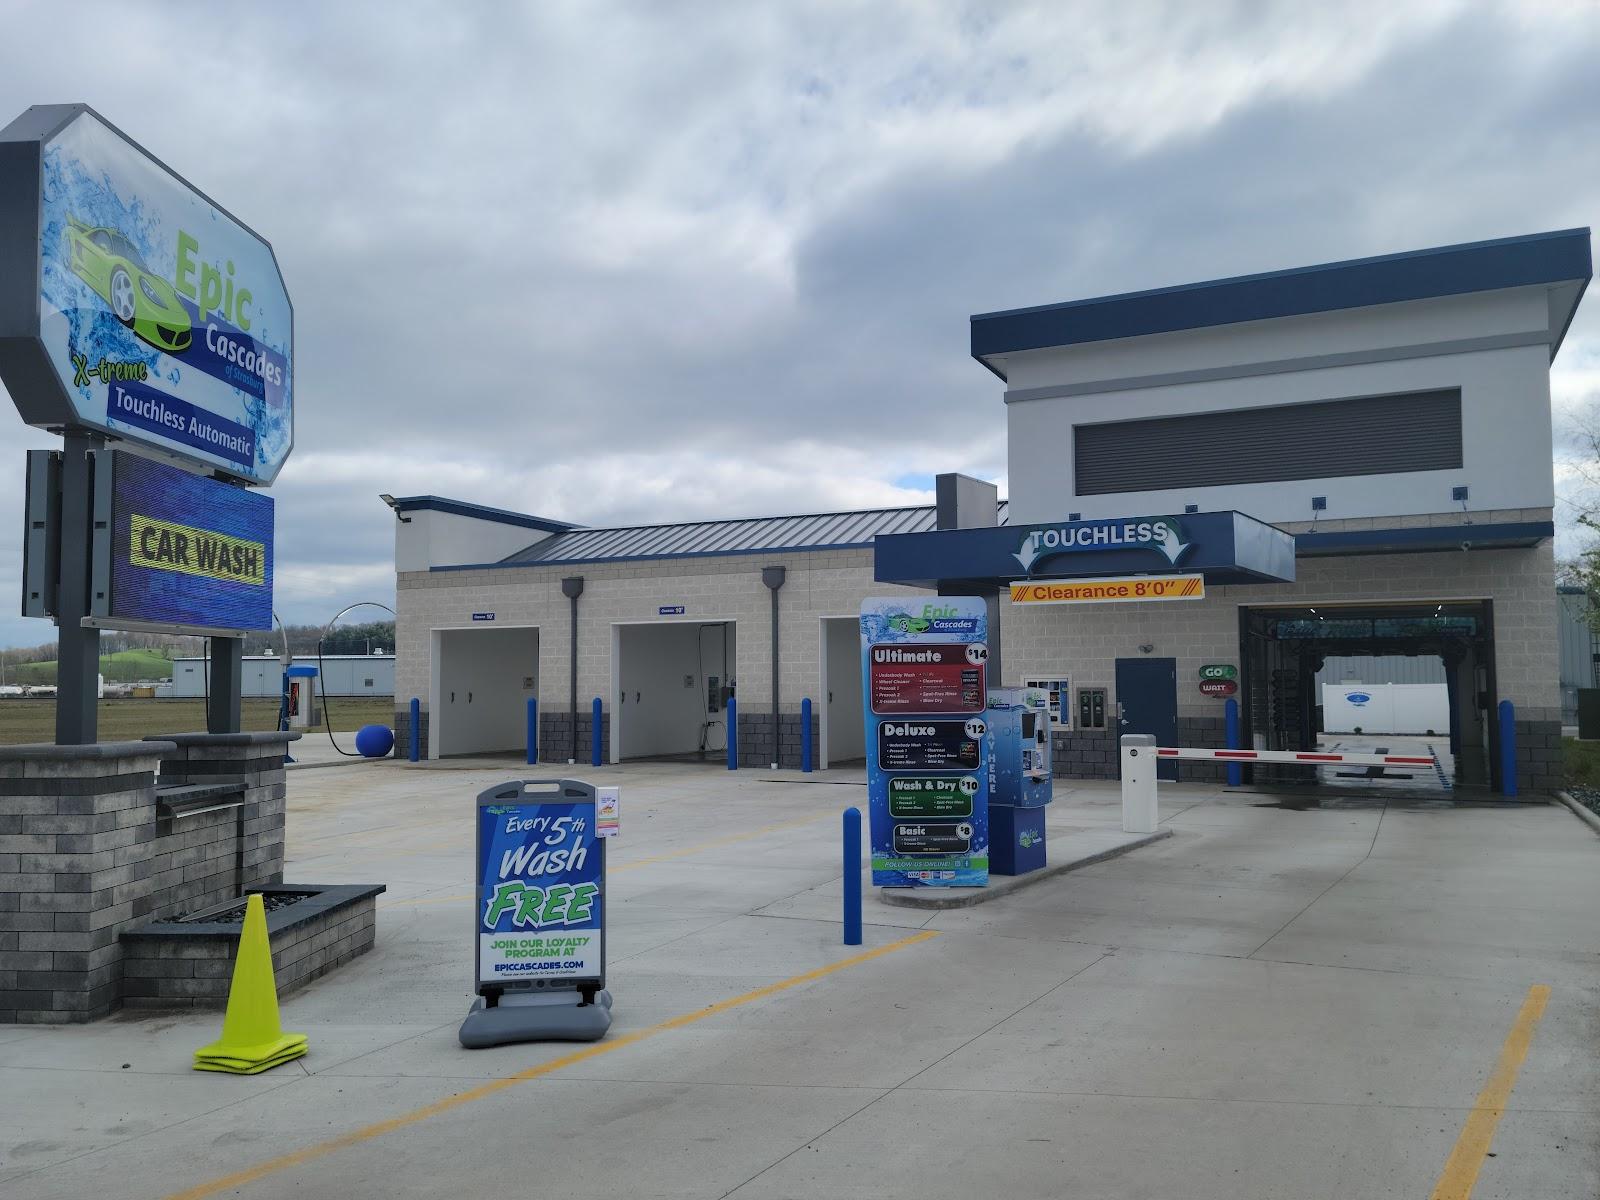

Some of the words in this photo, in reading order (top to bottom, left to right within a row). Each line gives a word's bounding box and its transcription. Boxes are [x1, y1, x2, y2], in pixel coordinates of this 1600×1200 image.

[175, 229, 253, 332] Epic
[205, 323, 282, 386] Cascades
[73, 354, 148, 387] X-treme
[225, 364, 234, 376] of
[115, 386, 185, 431] Touchless
[188, 416, 250, 456] Automatic
[1029, 521, 1168, 549] TOUCHLESS
[140, 526, 189, 566] CAR
[195, 536, 257, 577] WASH
[1033, 584, 1129, 600] Clearance
[922, 604, 958, 622] Epic
[934, 620, 972, 629] Cascades
[874, 648, 942, 663] Ultimate
[968, 648, 988, 660] $14
[1205, 668, 1223, 677] GO
[1203, 684, 1226, 692] WAIT
[884, 723, 936, 736] Deluxe
[967, 724, 985, 734] $12
[894, 780, 922, 791] Wash
[925, 781, 934, 790] &
[937, 780, 956, 792] Dry
[962, 780, 978, 791] $10
[505, 816, 551, 834] Every
[899, 826, 926, 836] Basic
[960, 826, 970, 835] $8
[499, 836, 588, 879] Wash
[485, 881, 598, 928] FREE
[490, 940, 517, 949] JOIN
[520, 939, 543, 948] OUR
[546, 937, 590, 947] LOYALTY
[505, 948, 560, 958] PROGRAM
[563, 947, 575, 956] AT
[494, 961, 584, 972] EPICCASCADES.COM
